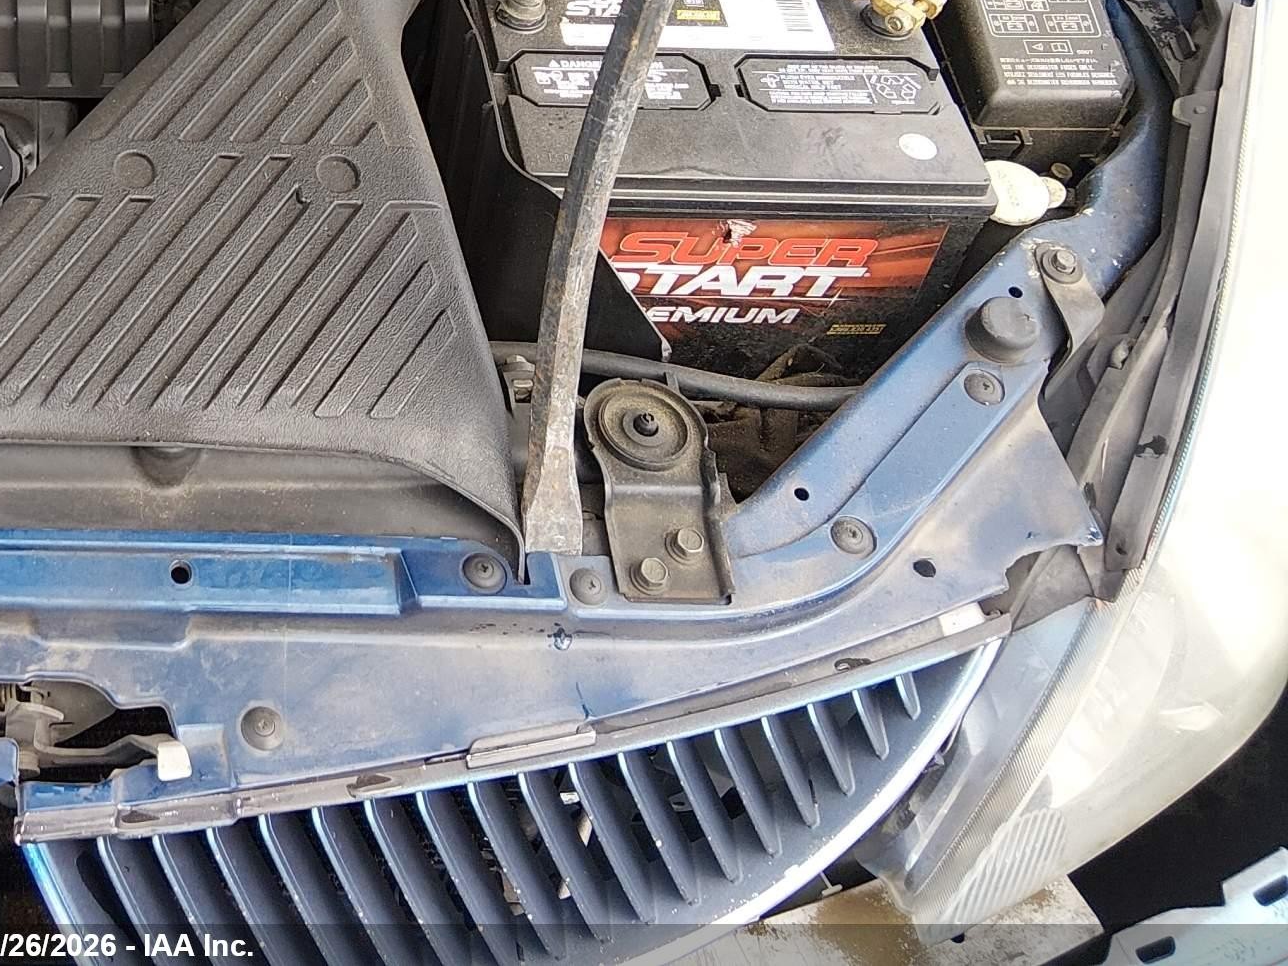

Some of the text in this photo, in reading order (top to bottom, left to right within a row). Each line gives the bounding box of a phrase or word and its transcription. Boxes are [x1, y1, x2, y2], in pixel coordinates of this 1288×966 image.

[565, 2, 621, 17] STA
[560, 59, 603, 69] DANGE
[611, 231, 879, 267] SUPER
[645, 305, 801, 324] EMIUM
